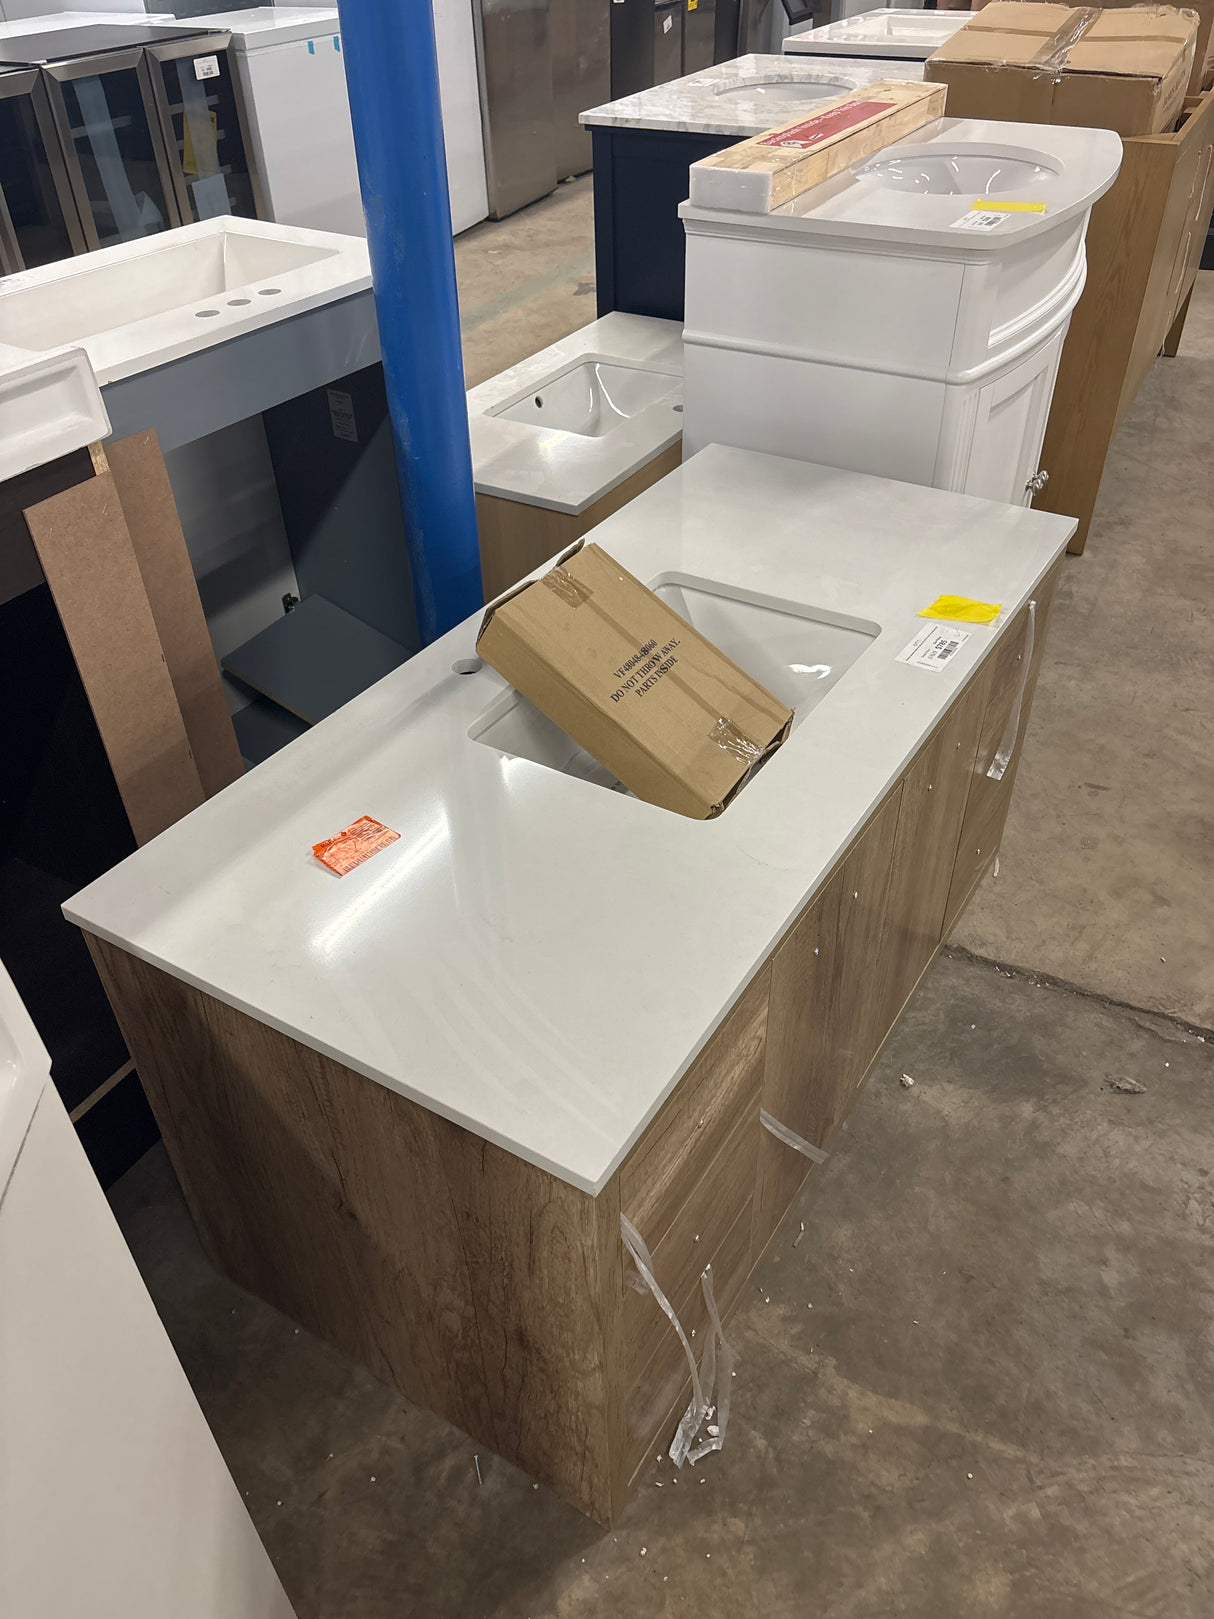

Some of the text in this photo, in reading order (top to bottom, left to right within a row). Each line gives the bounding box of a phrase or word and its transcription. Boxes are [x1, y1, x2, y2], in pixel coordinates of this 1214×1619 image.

[610, 637, 681, 703] DO NOT THROW AWAY.
[635, 655, 679, 697] PARTS INSIDE
